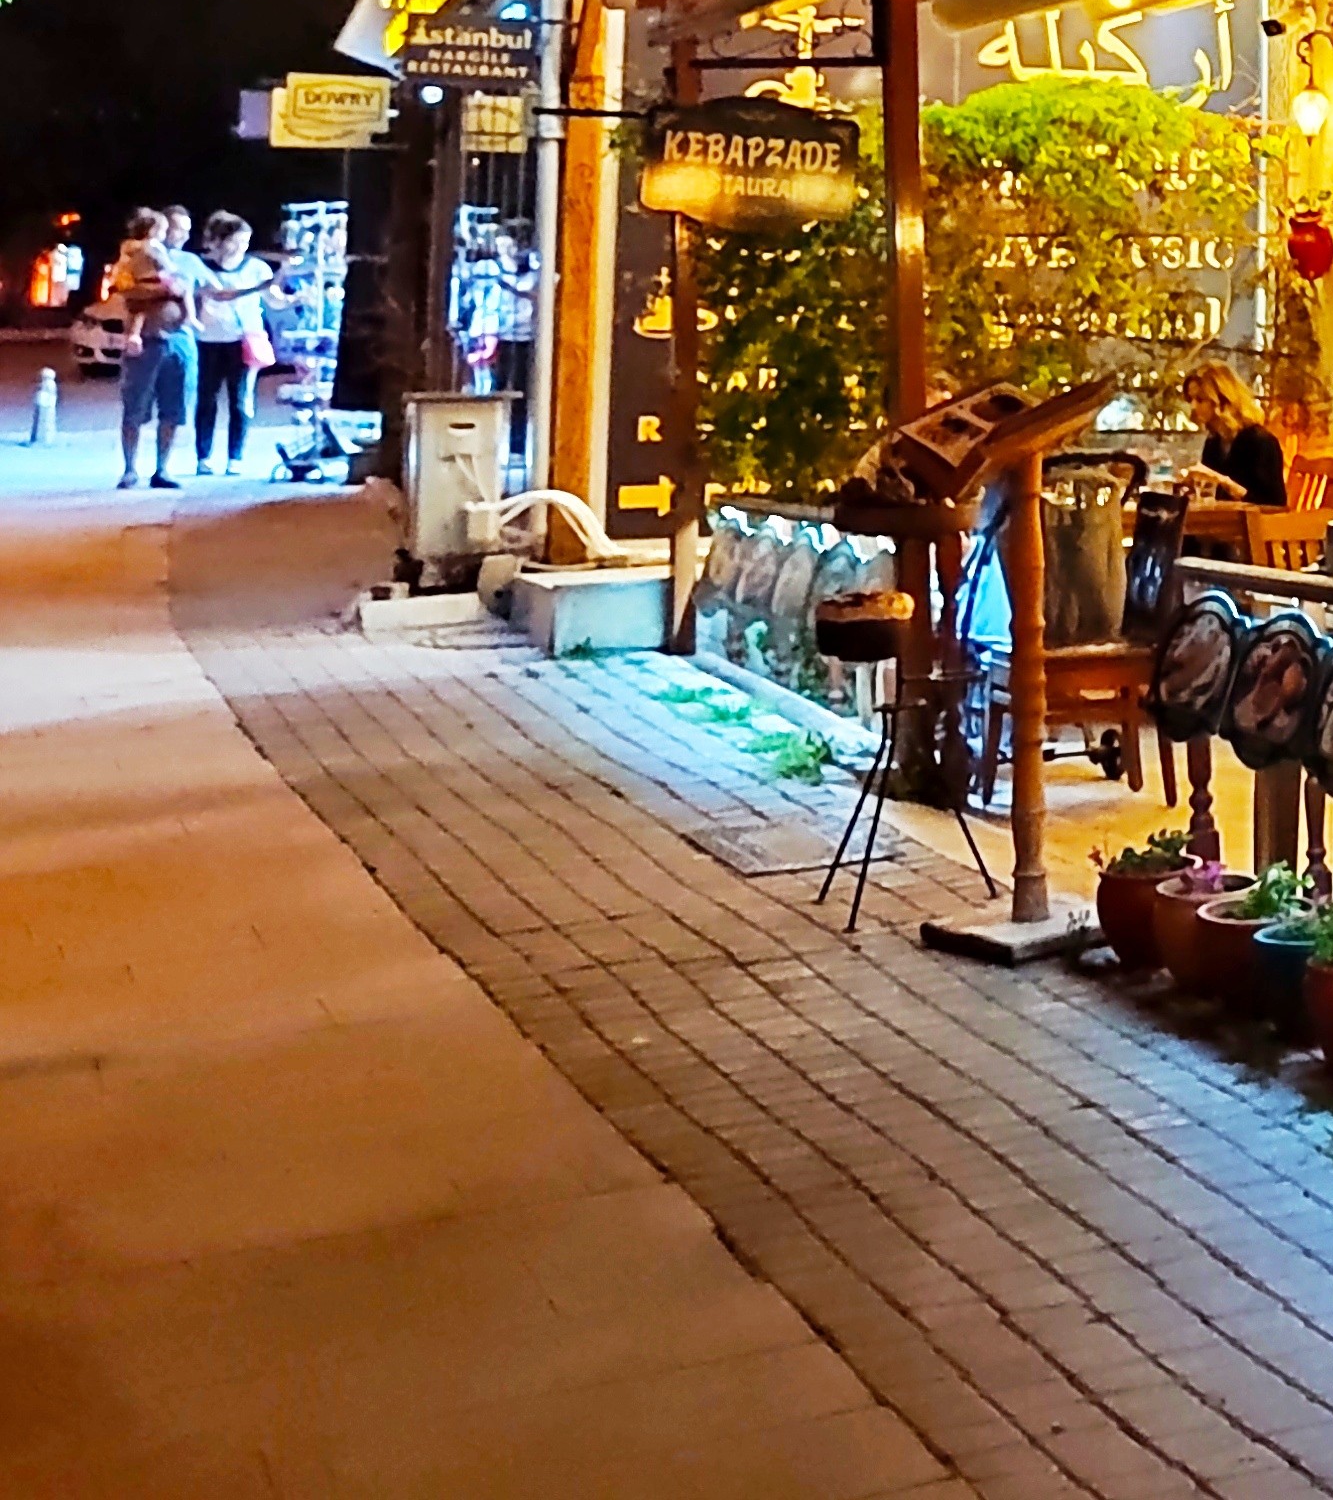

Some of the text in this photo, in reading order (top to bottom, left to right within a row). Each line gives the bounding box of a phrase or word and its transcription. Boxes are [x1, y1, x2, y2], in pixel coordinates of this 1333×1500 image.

[406, 60, 529, 79] RESTAURANT
[304, 90, 375, 107] DOWRY
[662, 128, 842, 174] KEBAPZADE
